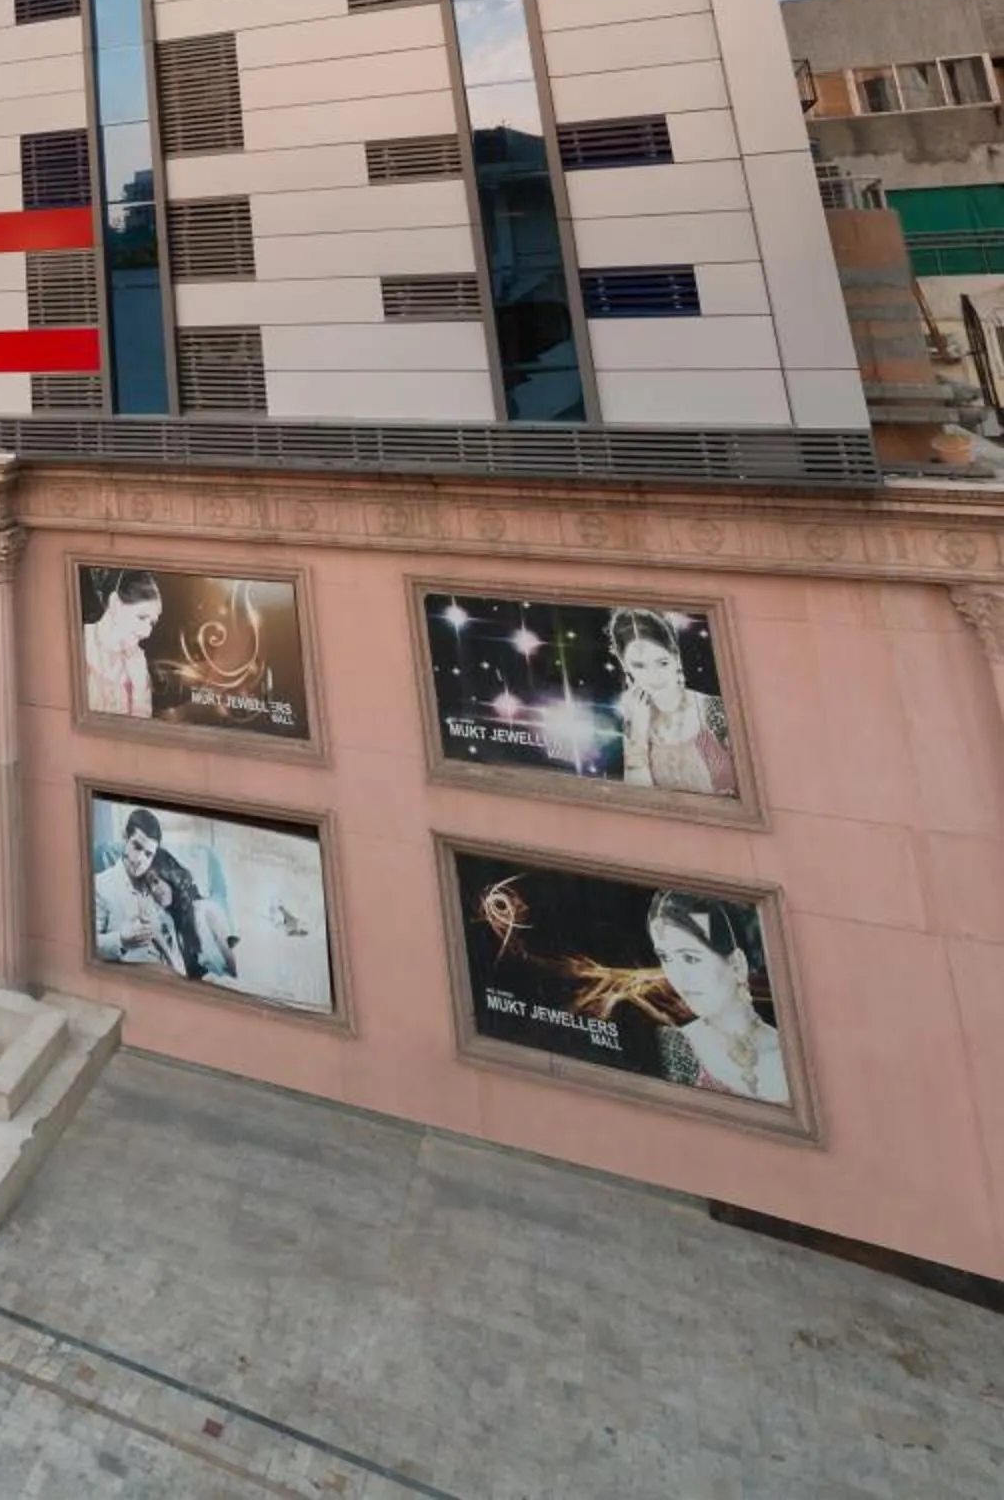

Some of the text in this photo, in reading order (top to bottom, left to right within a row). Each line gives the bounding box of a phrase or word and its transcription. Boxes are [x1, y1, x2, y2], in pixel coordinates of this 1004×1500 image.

[449, 723, 486, 739] MUKT
[486, 994, 619, 1037] MUKT JEWELLERS
[590, 1033, 623, 1051] MALL
